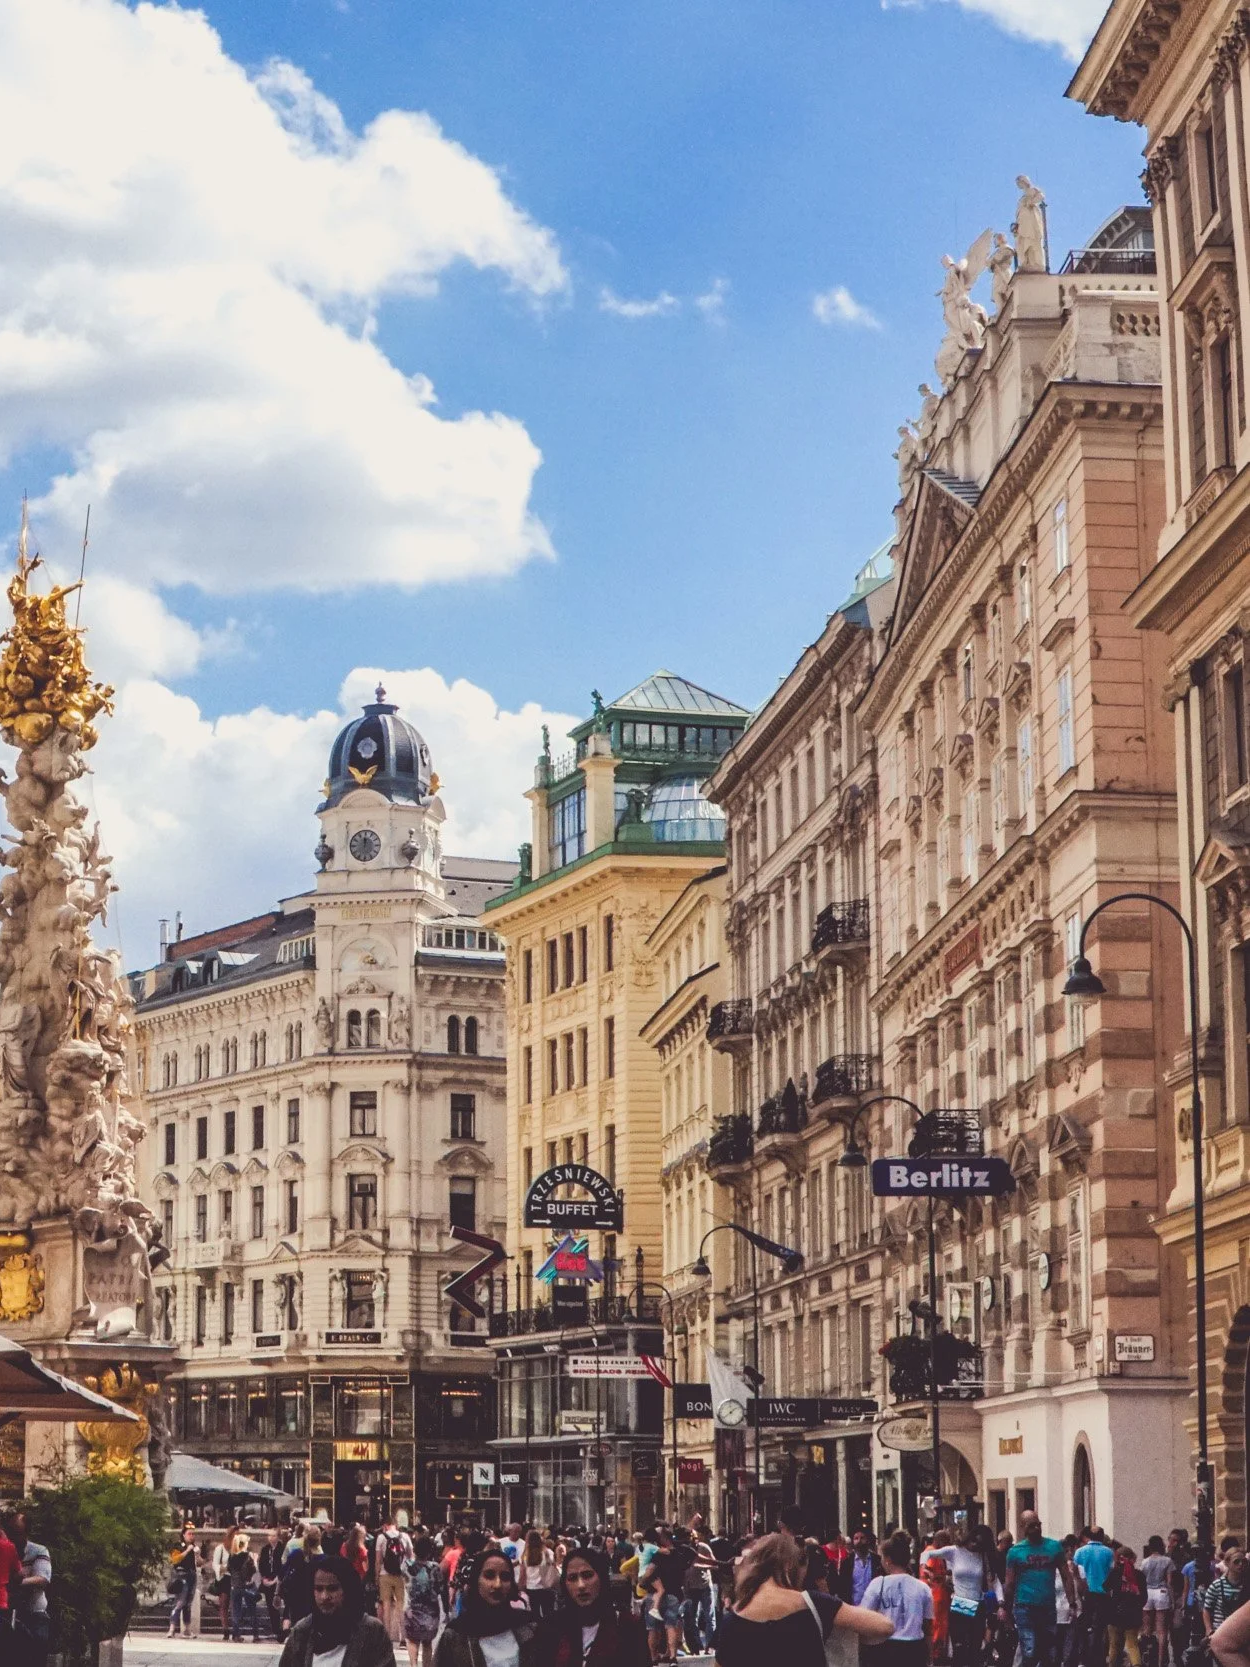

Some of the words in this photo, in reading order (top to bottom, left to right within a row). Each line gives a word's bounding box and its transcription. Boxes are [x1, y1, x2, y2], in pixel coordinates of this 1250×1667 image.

[889, 1163, 990, 1188] Berlitz
[530, 1168, 616, 1212] TRZESNIEWSKI
[547, 1203, 598, 1216] BUFFET
[769, 1403, 796, 1415] IWC
